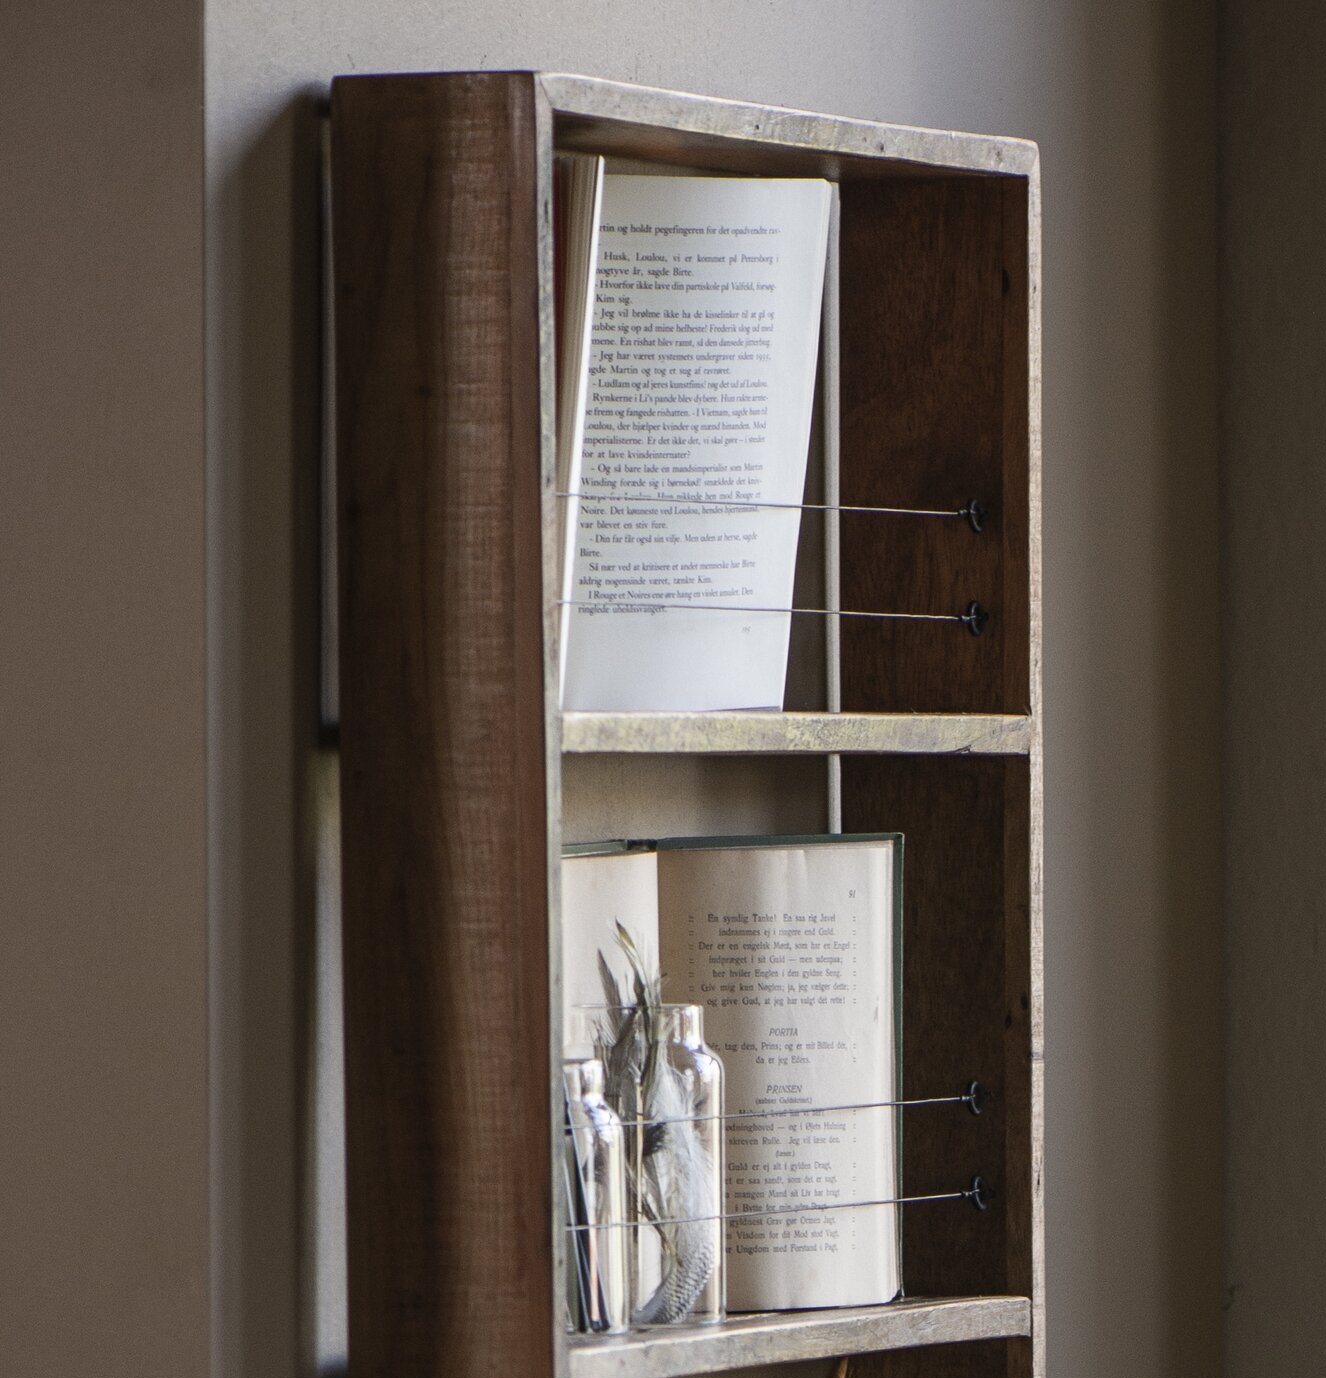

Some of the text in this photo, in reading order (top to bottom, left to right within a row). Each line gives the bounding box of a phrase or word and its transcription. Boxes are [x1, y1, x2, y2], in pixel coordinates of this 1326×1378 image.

[617, 223, 730, 238] og holdt pegefingeren for det
[604, 251, 630, 262] Husk,
[636, 252, 668, 263] Loulou,
[697, 253, 725, 263] kommet
[648, 266, 670, 280] sagde
[673, 266, 694, 276] Birte.
[600, 279, 635, 289] Hvorfor
[636, 280, 653, 290] ikke
[654, 281, 670, 290] lave
[672, 281, 684, 291] din
[596, 293, 632, 307] Kim sig.
[600, 308, 703, 322] Jeg vil ikke ha de
[617, 322, 629, 335] sig
[630, 325, 642, 336] op
[643, 322, 653, 332] ad
[620, 336, 632, 346] En
[657, 336, 673, 346] blev
[599, 350, 614, 364] Jeg
[616, 350, 630, 360] har
[633, 352, 655, 360] været
[610, 364, 638, 374] Martin
[641, 367, 651, 378] og
[654, 366, 666, 378] tog
[598, 378, 630, 388] Ludlam
[631, 381, 641, 392] og
[651, 378, 668, 392] jeres
[592, 392, 633, 406] Rynkerne
[654, 392, 677, 406] pande
[593, 406, 656, 420] frem og fangede
[617, 420, 630, 430] der
[632, 420, 661, 434] hjælper
[662, 420, 690, 430] kvinder
[647, 435, 687, 444] Er det ikke
[582, 449, 594, 458] for
[608, 449, 625, 458] lave
[597, 463, 611, 476] Og
[624, 463, 642, 473] bare
[643, 463, 659, 473] lade
[661, 465, 670, 473] en
[580, 476, 659, 491] Winding sig
[580, 505, 673, 515] Noire. Det ved
[580, 519, 648, 529] var blevet en stiv
[595, 533, 611, 543] Din
[612, 533, 623, 543] far
[580, 547, 602, 557] Birte.
[588, 561, 599, 571] Så
[618, 561, 631, 571] ved
[578, 575, 602, 589] aldrig
[593, 589, 617, 603] Rouge
[707, 913, 719, 922] En
[783, 913, 792, 922] En
[698, 941, 713, 950] Der
[706, 996, 738, 1008] og give
[768, 1028, 798, 1037] PORTIA
[784, 1042, 794, 1053] og
[755, 1054, 764, 1064] da
[766, 1085, 803, 1094] PRINSEN
